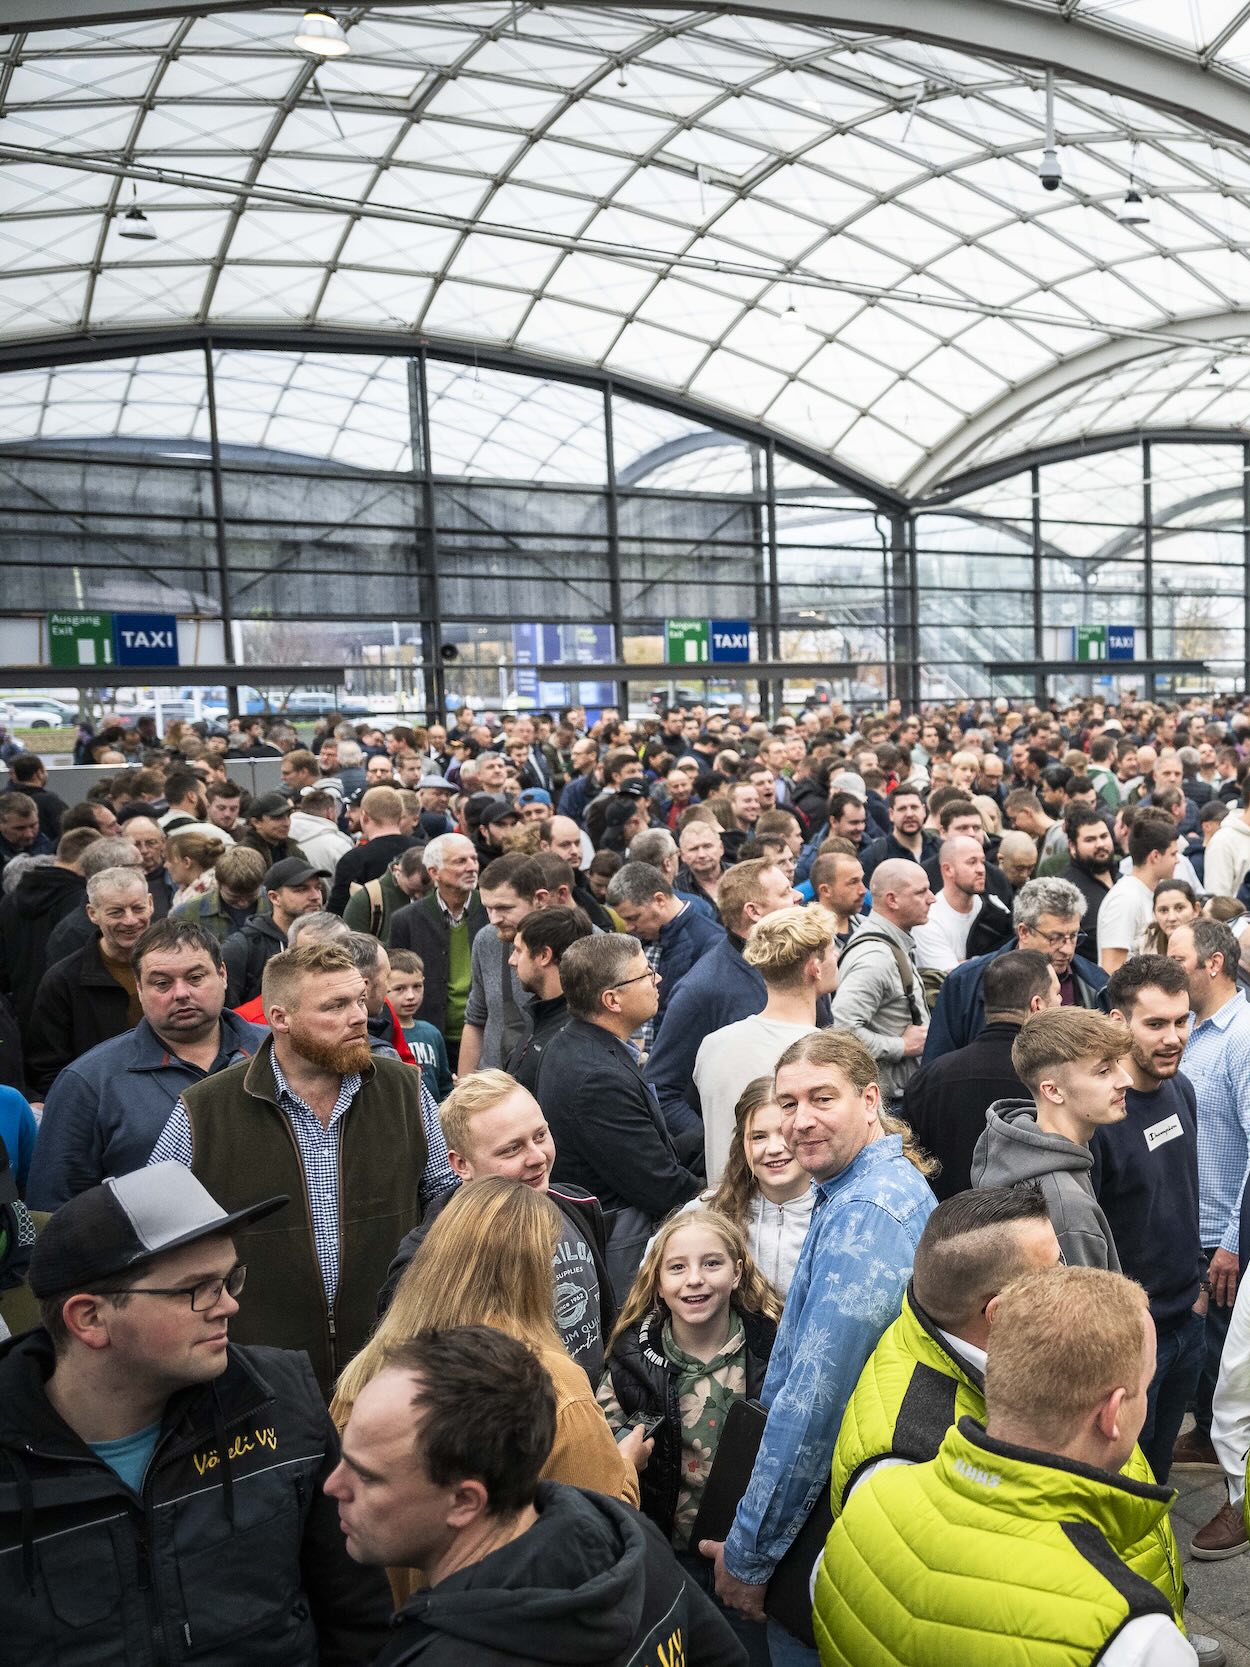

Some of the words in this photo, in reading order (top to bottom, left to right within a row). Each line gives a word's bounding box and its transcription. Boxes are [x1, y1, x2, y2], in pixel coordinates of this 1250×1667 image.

[52, 614, 101, 627] Ausgang
[52, 626, 74, 636] Exit
[121, 631, 174, 648] TAXI
[714, 633, 748, 648] TAXI
[556, 1266, 584, 1281] SUPPLIES
[570, 1292, 585, 1304] 1962
[193, 1436, 255, 1475] Vöeli
